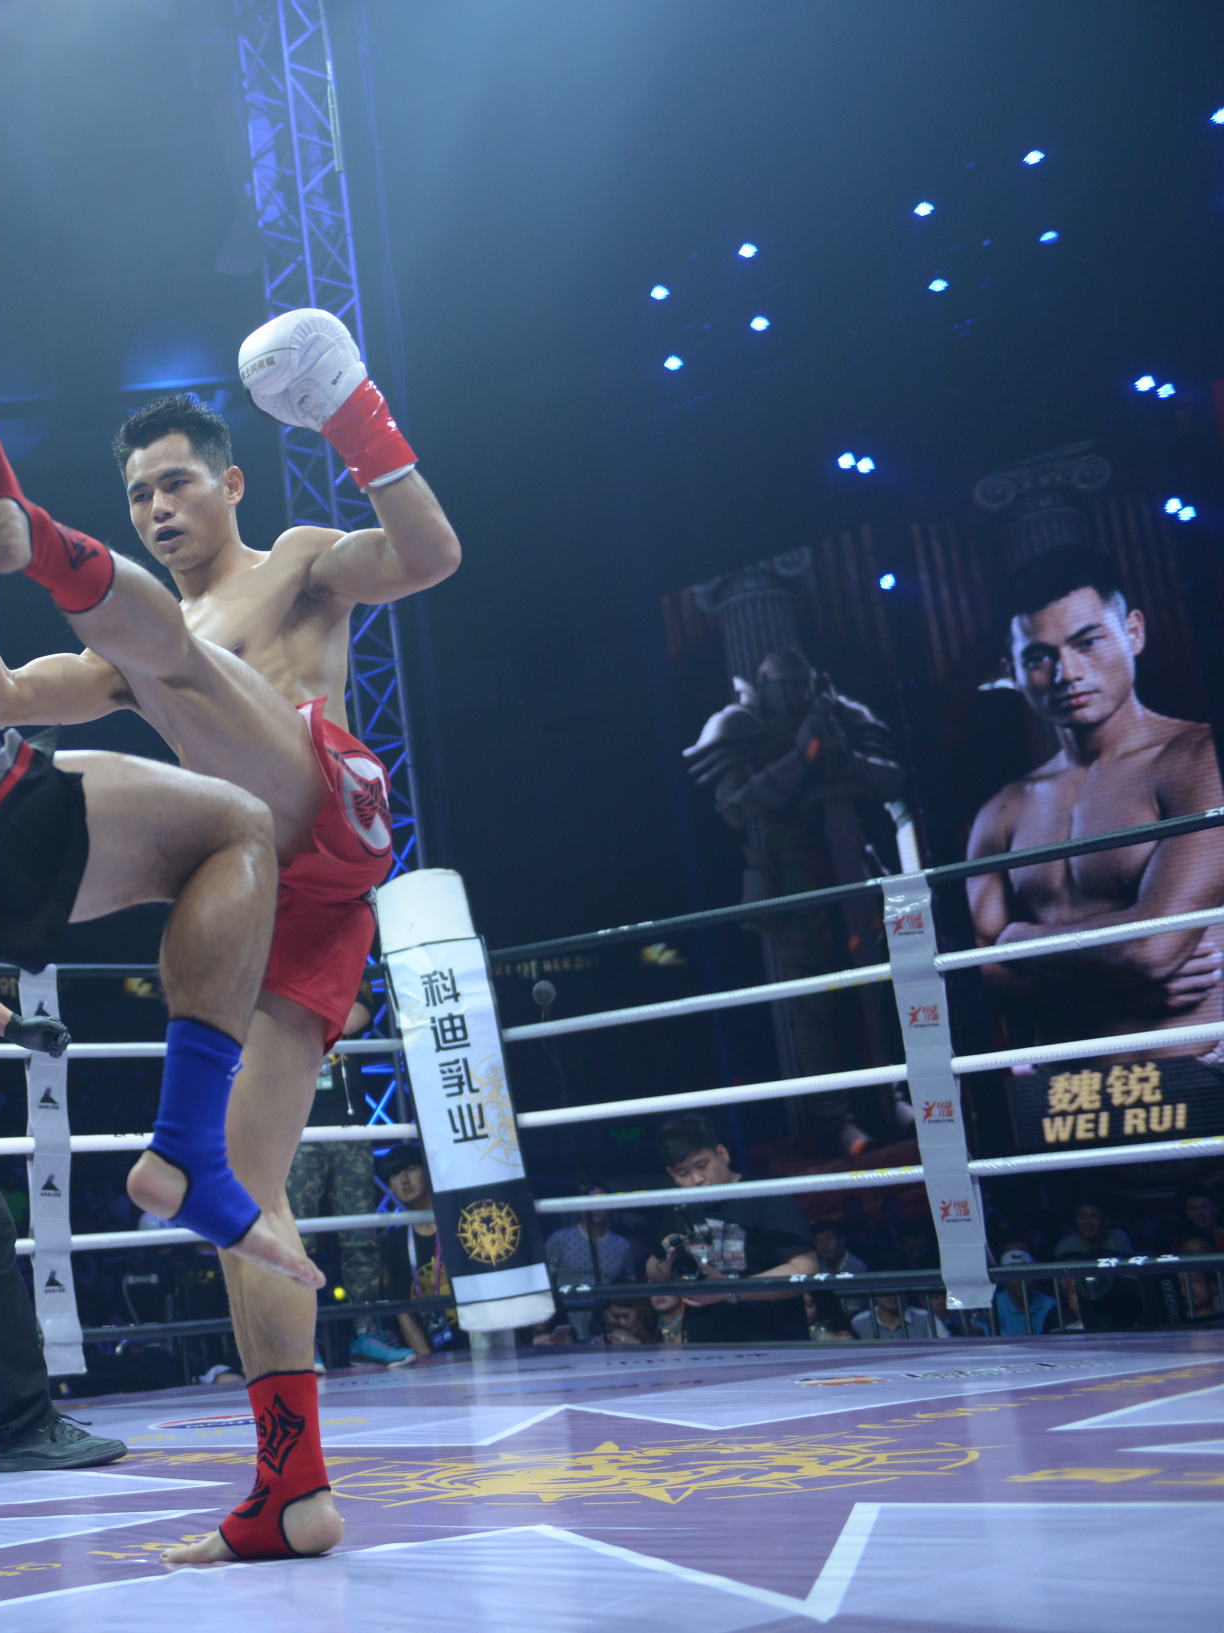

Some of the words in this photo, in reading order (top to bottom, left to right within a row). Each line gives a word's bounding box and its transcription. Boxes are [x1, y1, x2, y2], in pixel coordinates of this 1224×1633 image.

[420, 967, 490, 1145] 科迪乳业
[1048, 1062, 1163, 1113] 魏锐
[1043, 1111, 1108, 1143] WEI
[1124, 1103, 1187, 1135] RUI
